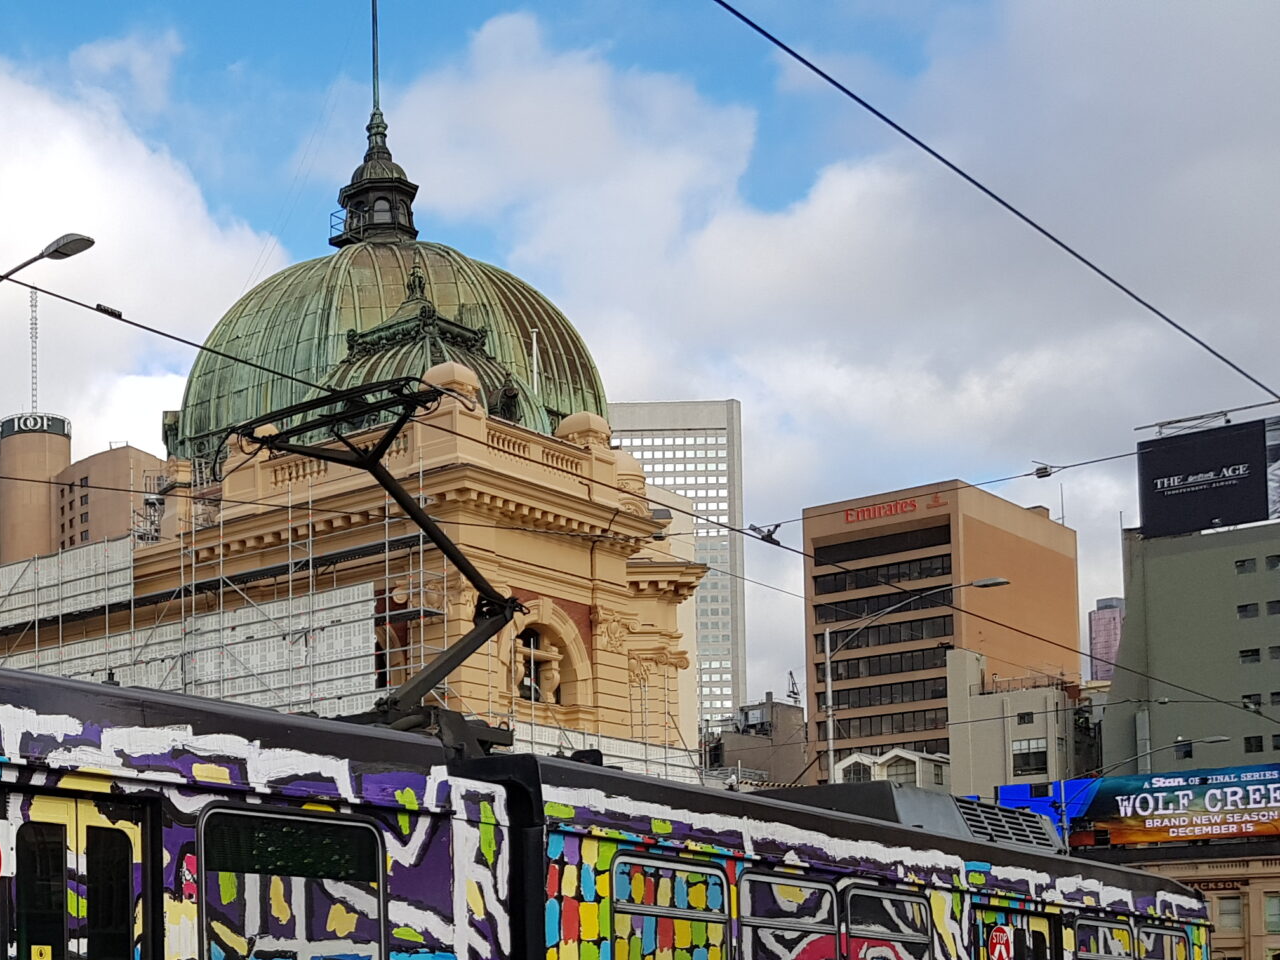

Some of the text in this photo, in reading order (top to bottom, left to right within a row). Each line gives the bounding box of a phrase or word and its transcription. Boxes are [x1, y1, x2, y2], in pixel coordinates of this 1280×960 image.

[13, 415, 52, 432] IOOF
[1153, 463, 1250, 489] THE AGE
[844, 499, 918, 524] Emirates
[1143, 781, 1150, 789] A
[1241, 770, 1279, 781] SERIES
[1115, 790, 1194, 817] WOLF
[1145, 810, 1279, 829] BRAND NEW SEASON
[1169, 822, 1254, 837] DECEMBER 15
[992, 932, 1008, 944] STOP
